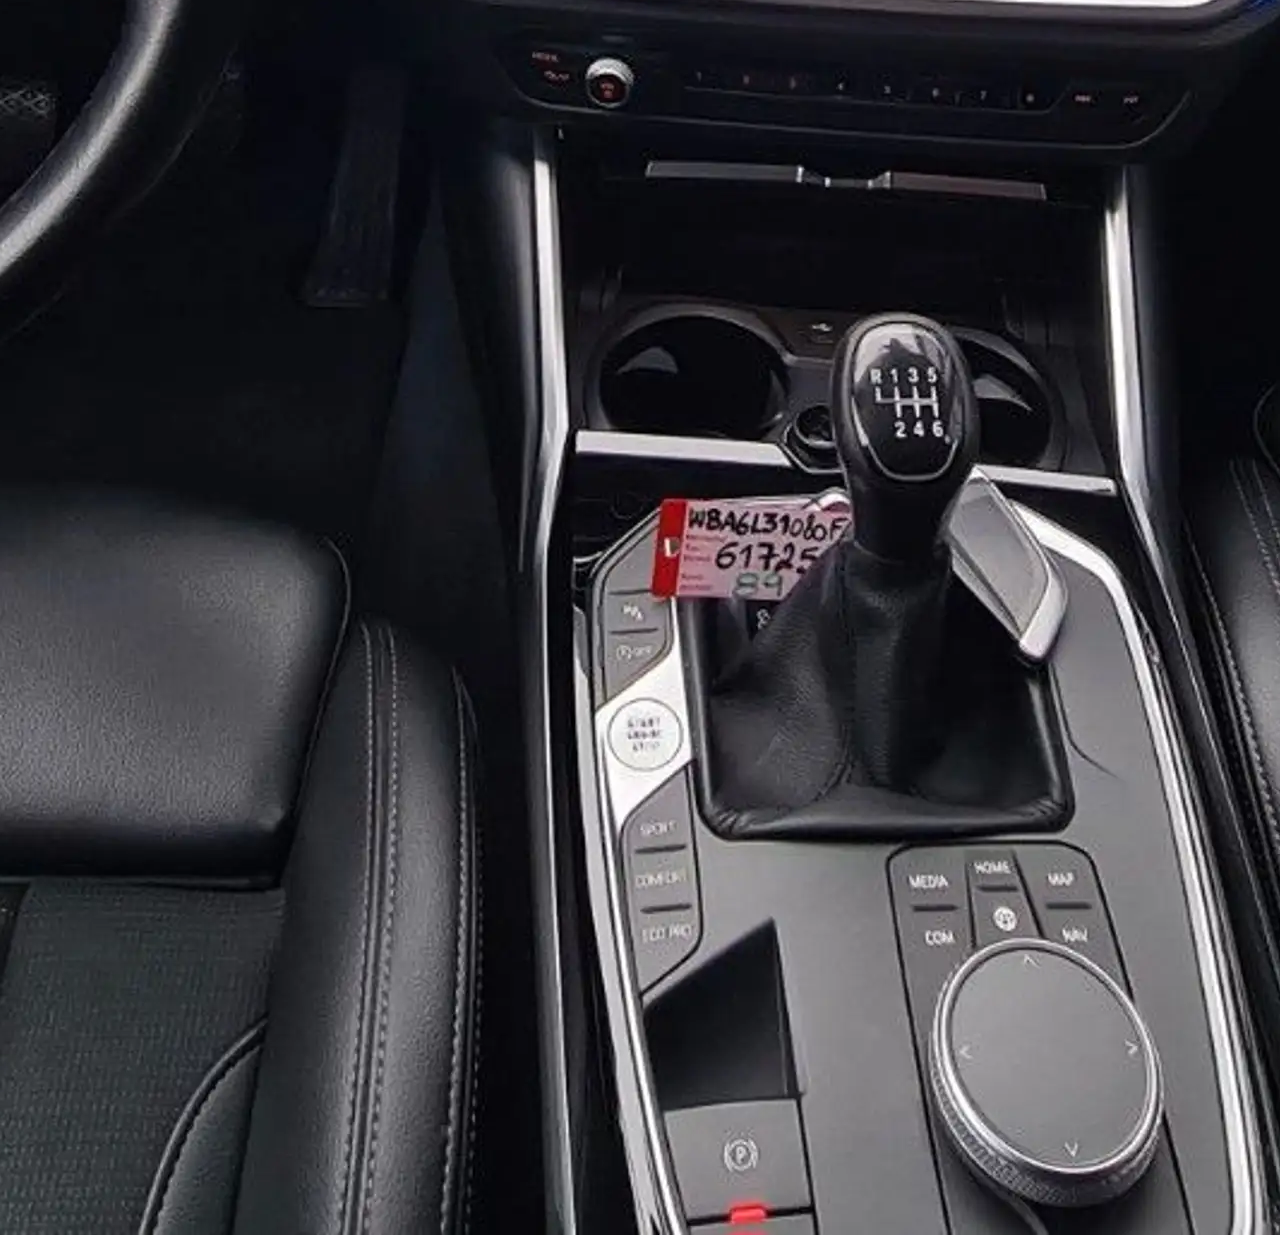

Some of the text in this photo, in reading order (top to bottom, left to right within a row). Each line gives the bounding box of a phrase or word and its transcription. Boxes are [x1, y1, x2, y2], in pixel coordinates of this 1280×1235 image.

[871, 367, 937, 384] R 1 3 5
[894, 420, 944, 438] 2 4 6
[974, 861, 1012, 874] HOME
[908, 875, 948, 888] MEDIA
[1047, 873, 1075, 886] MAP
[925, 930, 956, 945] COM
[1062, 929, 1088, 942] NAV
